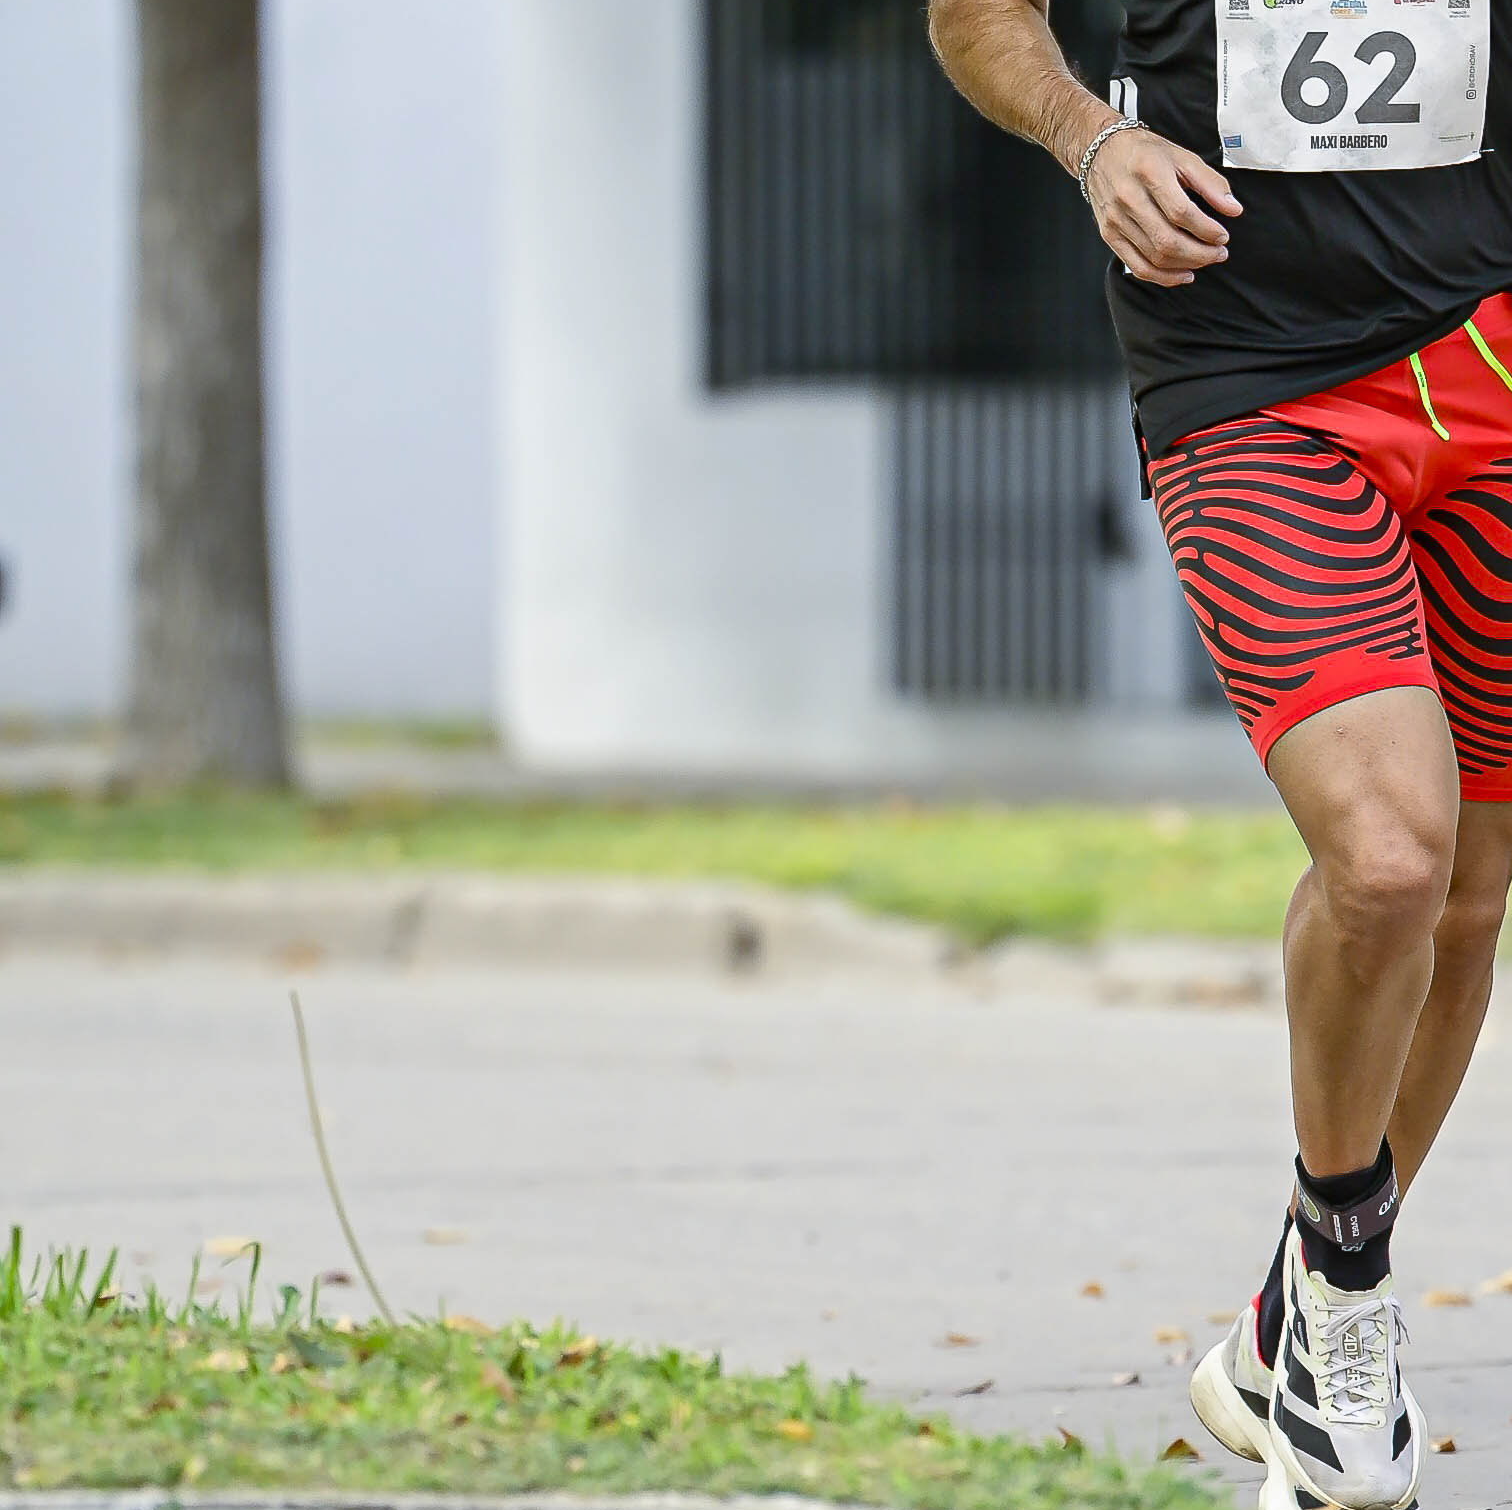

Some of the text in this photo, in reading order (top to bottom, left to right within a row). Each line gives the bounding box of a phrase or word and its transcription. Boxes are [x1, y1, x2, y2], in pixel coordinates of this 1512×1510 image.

[1281, 31, 1420, 124] 62
[1310, 134, 1388, 149] MAXI BARBERO
